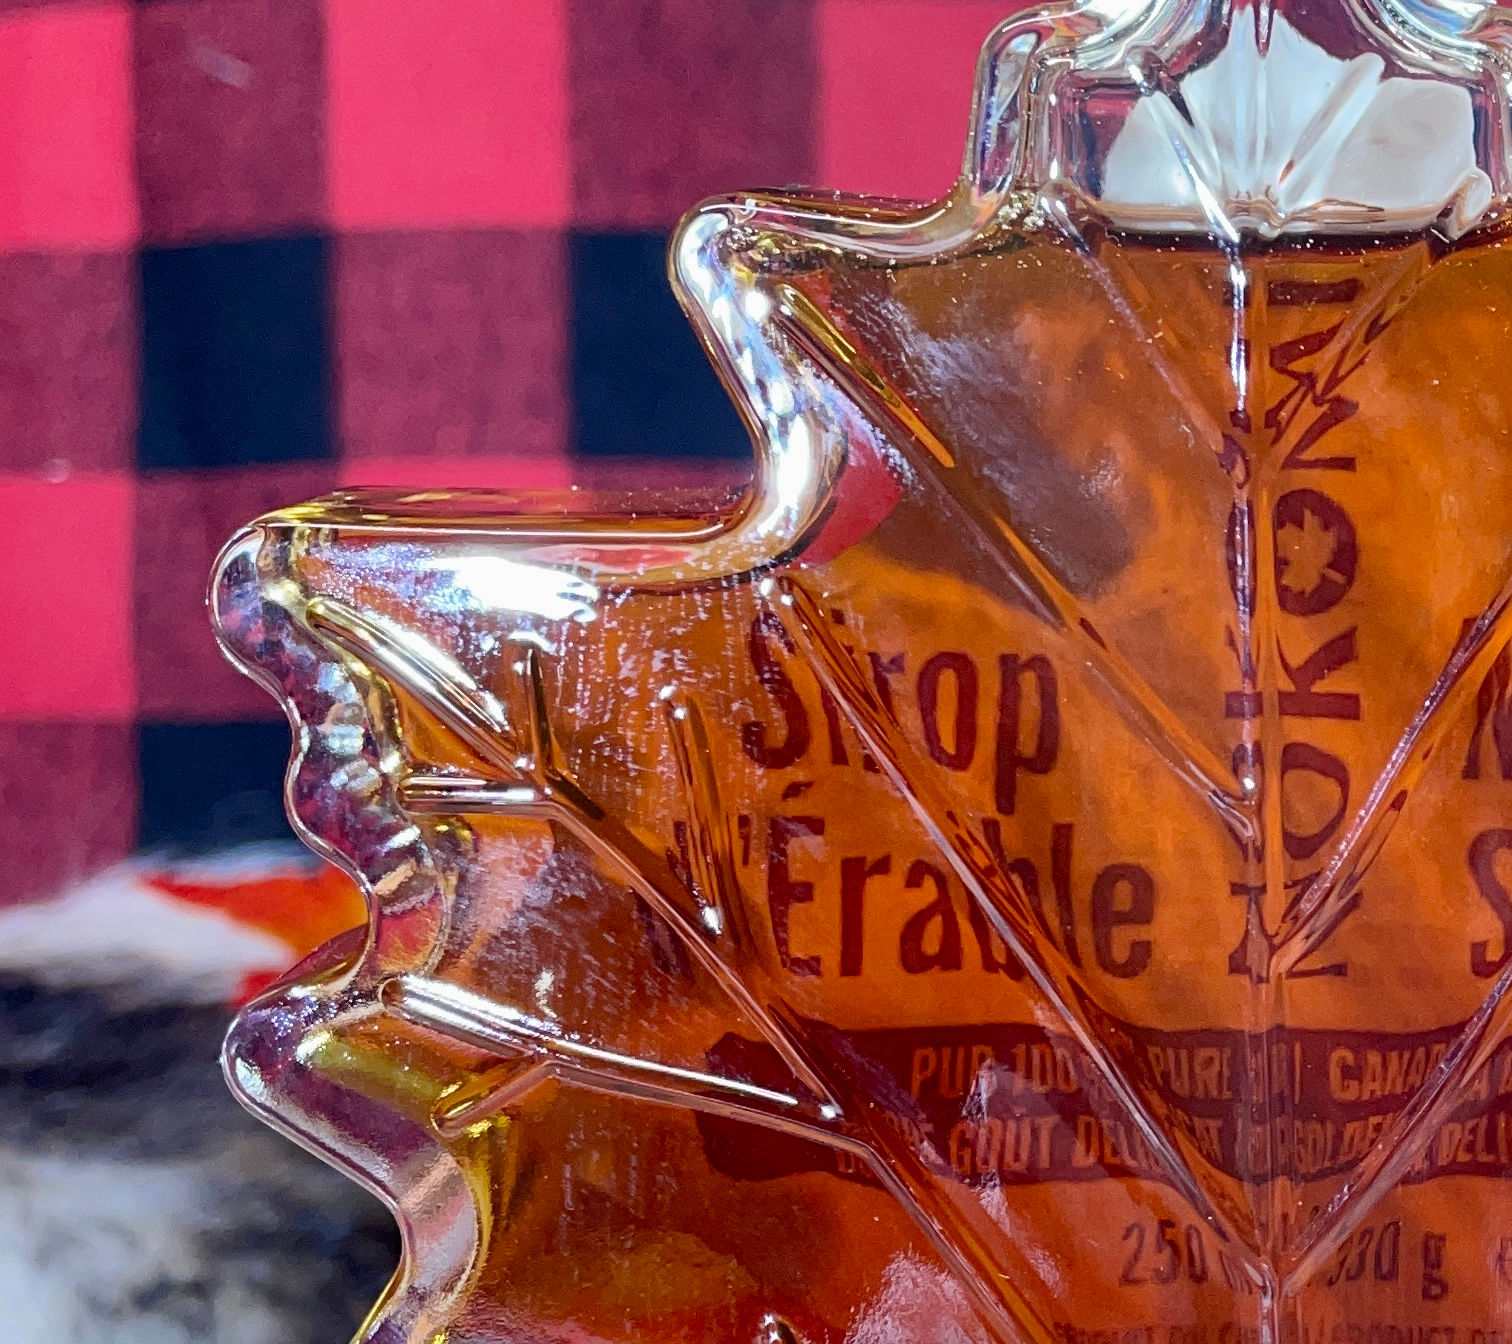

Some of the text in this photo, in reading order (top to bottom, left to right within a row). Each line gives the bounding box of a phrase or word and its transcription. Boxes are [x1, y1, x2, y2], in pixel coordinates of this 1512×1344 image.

[742, 608, 1060, 814] Sirop
[1329, 1042, 1490, 1102] CANAA
[1119, 1218, 1210, 1286] 250
